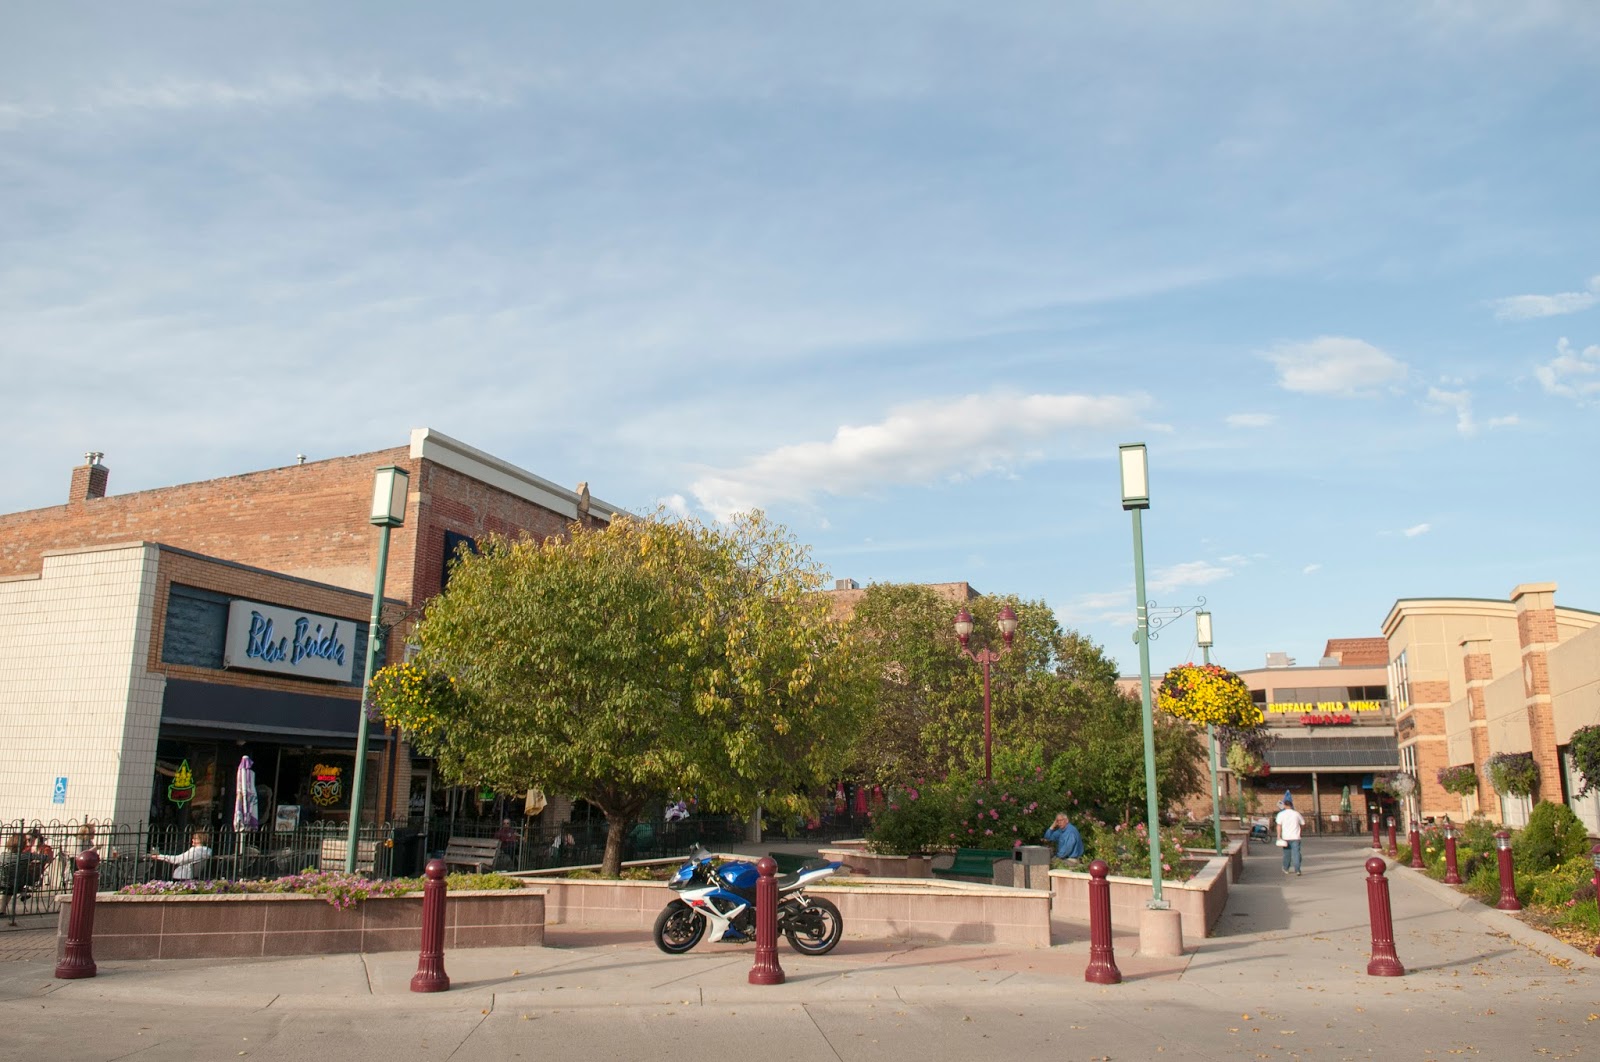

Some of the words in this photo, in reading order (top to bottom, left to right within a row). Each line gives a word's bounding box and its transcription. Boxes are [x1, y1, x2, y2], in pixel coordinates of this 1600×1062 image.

[246, 610, 288, 663] Blue
[290, 616, 346, 666] Bricks
[1268, 702, 1312, 713] BUFFALO
[1317, 701, 1344, 712] WILD
[1348, 701, 1381, 711] WINGS
